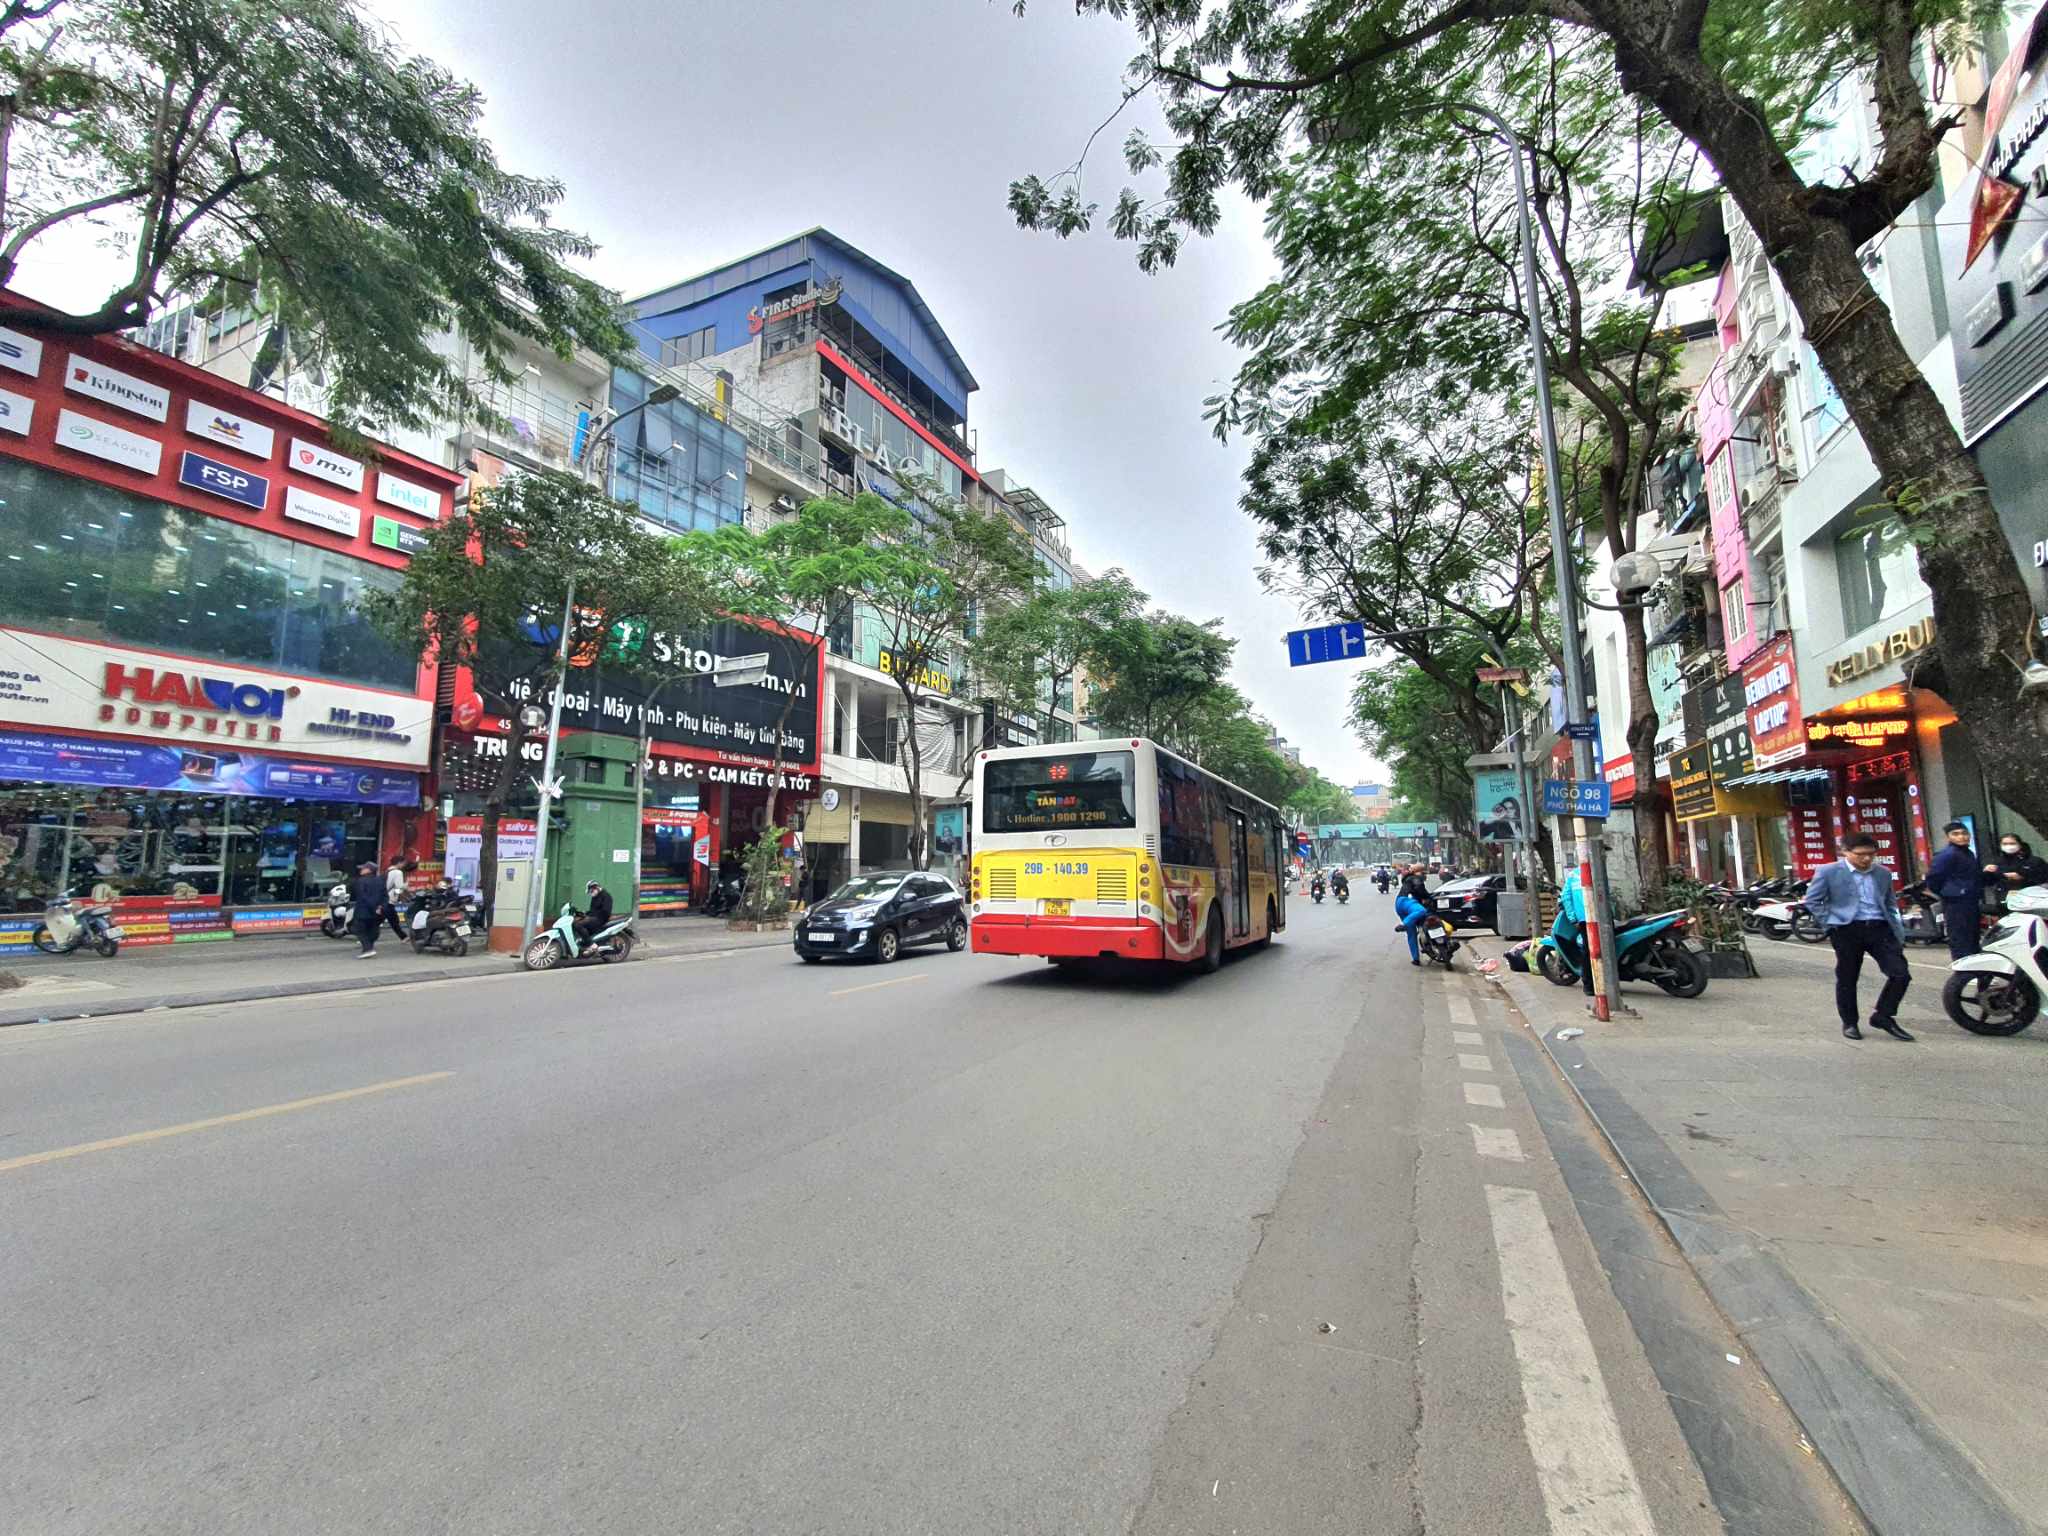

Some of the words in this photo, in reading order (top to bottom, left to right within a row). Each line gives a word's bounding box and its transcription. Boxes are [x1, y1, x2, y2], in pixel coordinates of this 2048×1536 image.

[91, 375, 163, 410] Kingston
[95, 433, 152, 459] SEAGATE
[201, 465, 248, 489] FSP
[390, 483, 428, 509] intel
[327, 515, 351, 527] Digital
[98, 703, 283, 743] COMPUTER
[329, 707, 396, 730] HI-END
[602, 694, 633, 723] Máy
[676, 711, 699, 736] Phụ
[1864, 720, 1909, 736] LAPTOP
[674, 763, 694, 778] PC
[708, 766, 737, 784] CAM
[740, 766, 764, 786] KẾT
[789, 772, 812, 791] TỐT
[1550, 785, 1580, 798] NGÕ
[1584, 788, 1601, 800] 98
[1054, 862, 1089, 875] 140.39
